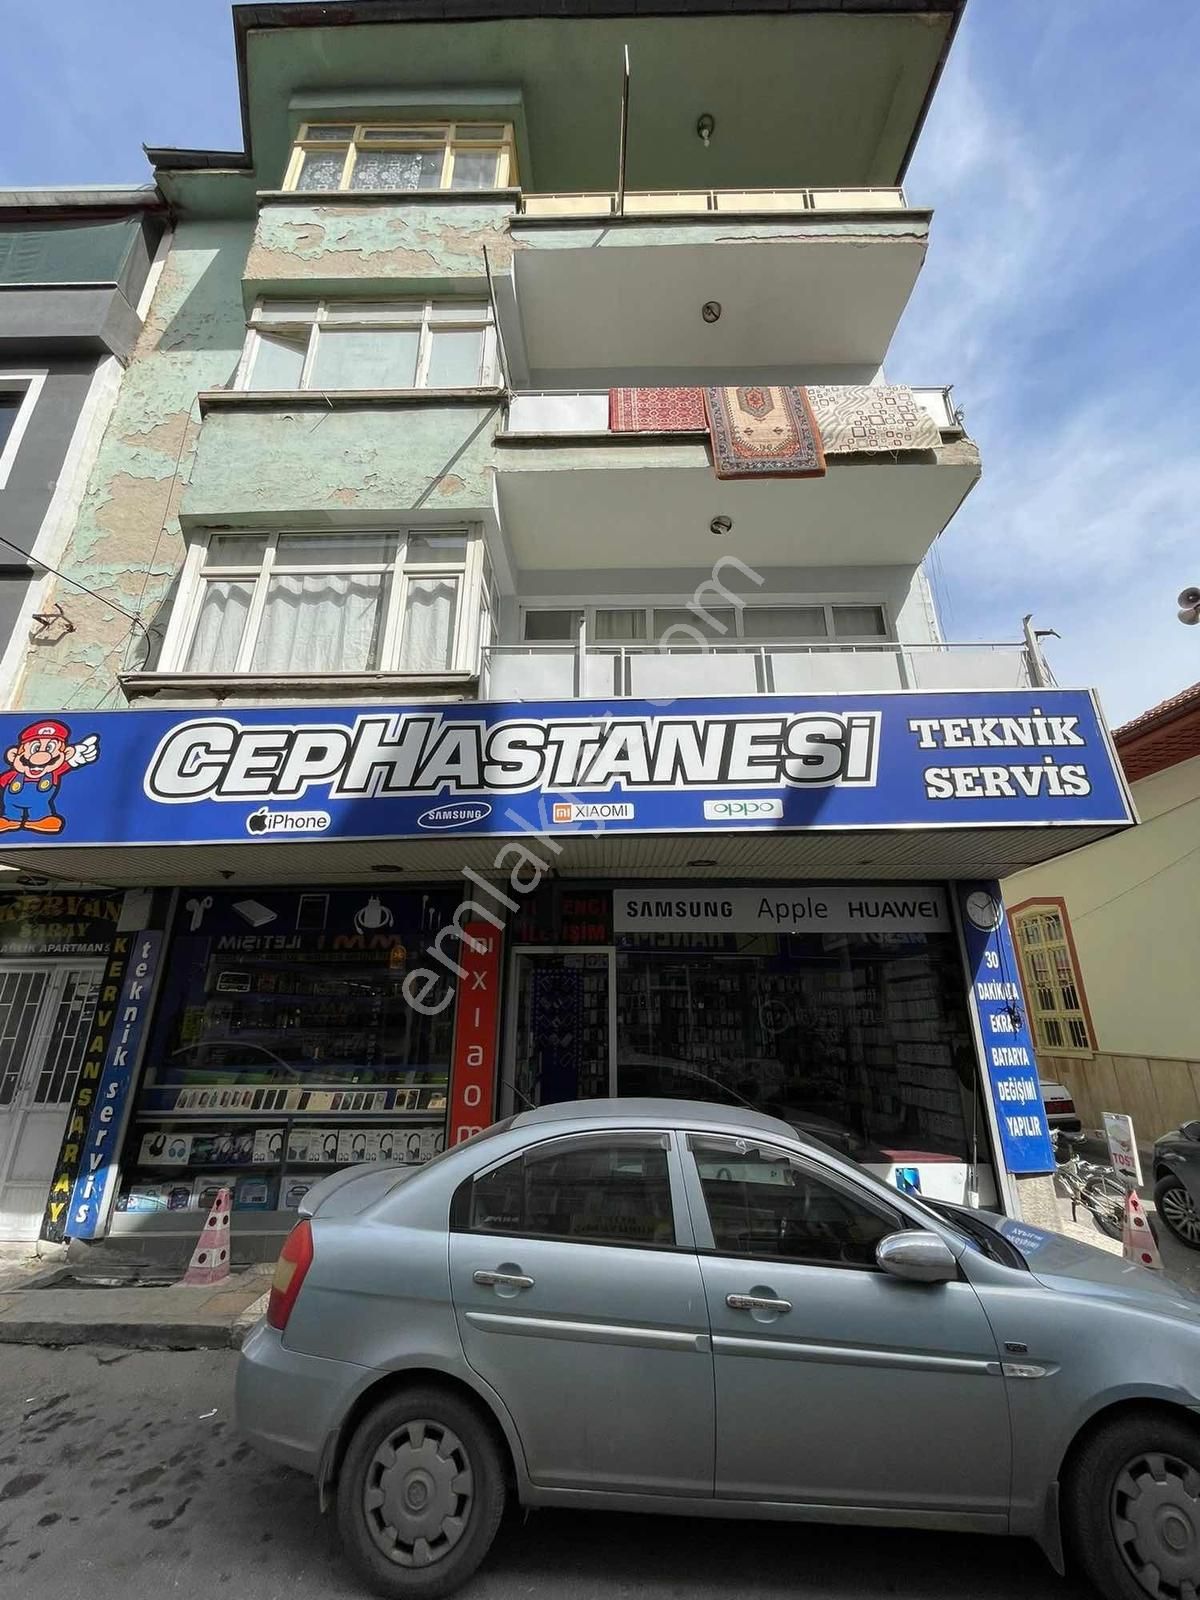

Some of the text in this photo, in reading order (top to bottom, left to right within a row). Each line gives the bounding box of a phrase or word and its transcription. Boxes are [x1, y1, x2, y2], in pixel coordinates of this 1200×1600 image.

[908, 708, 1085, 749] TEKNİK
[924, 756, 1091, 799] SERVİS
[428, 809, 482, 821] SAMSUNG
[576, 805, 629, 818] XIAOMI
[714, 802, 775, 817] oppo
[267, 814, 328, 830] iPhone
[626, 900, 733, 918] SAMSUNG
[757, 897, 829, 924] Apple
[848, 900, 940, 918] HUAWEI
[985, 951, 999, 969] 30
[989, 1014, 1020, 1033] EKRA
[992, 1048, 1030, 1066] BATARYA
[50, 938, 128, 1223] KERVANSARAY
[75, 941, 151, 1223] teknik servis
[999, 1076, 1037, 1105] DEĞİŞİMİ
[1006, 1117, 1042, 1136] YAPILIR
[1112, 1152, 1135, 1167] TOS
